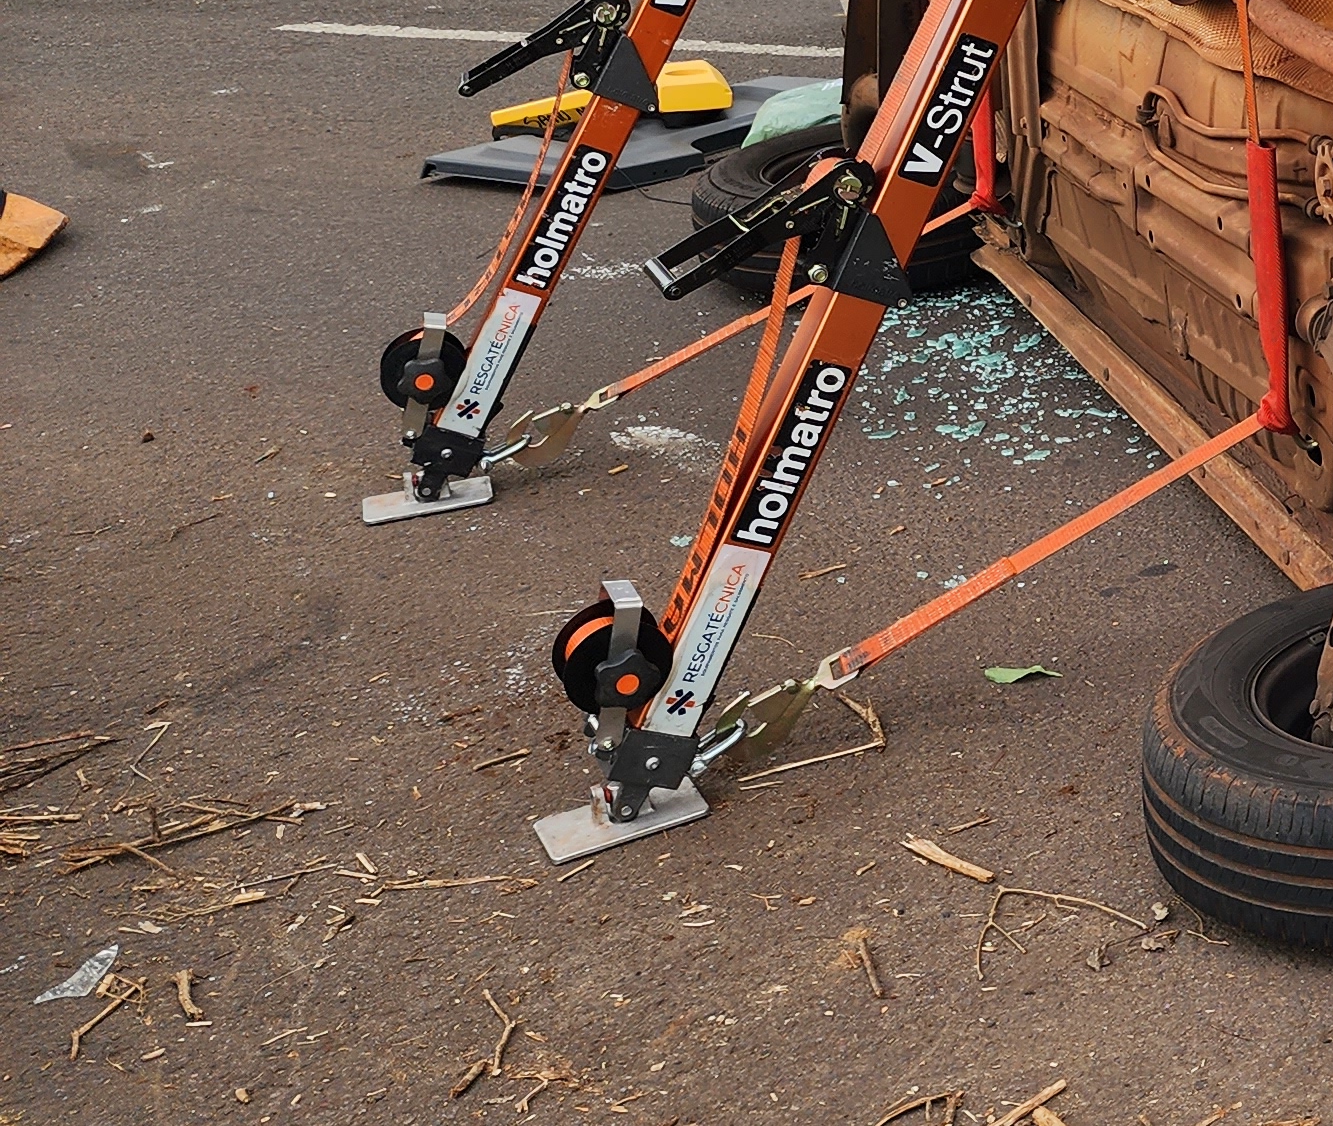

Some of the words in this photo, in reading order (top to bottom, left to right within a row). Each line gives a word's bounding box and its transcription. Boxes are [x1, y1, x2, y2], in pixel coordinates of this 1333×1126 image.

[903, 42, 994, 173] V-Strut
[515, 151, 607, 289] holmatro
[469, 304, 521, 395] RESGATÉCNICA
[736, 366, 846, 544] holmatro
[682, 564, 746, 683] RESGATÉCNICA
